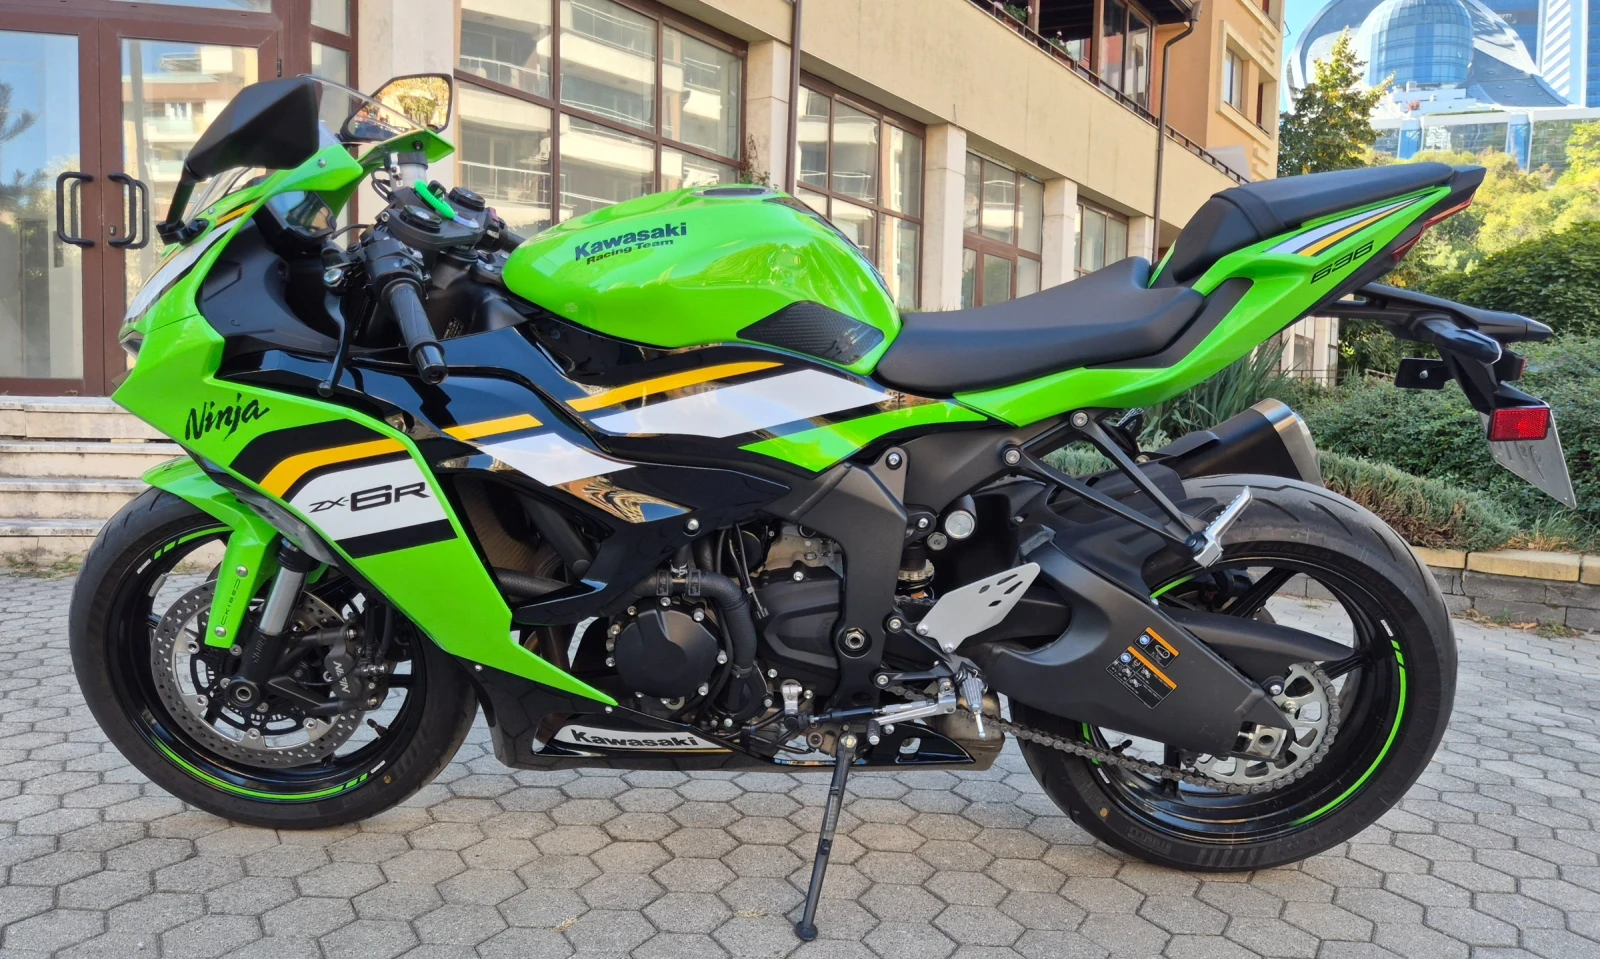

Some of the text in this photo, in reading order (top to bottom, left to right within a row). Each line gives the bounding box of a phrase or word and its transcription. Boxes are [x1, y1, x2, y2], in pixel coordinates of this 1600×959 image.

[575, 222, 687, 261] Kawasaki
[586, 240, 674, 265] Racing Team
[1310, 240, 1375, 284] 636
[185, 392, 270, 441] Ninja
[308, 481, 431, 513] ZX-6R
[570, 728, 699, 747] Kawasaki
